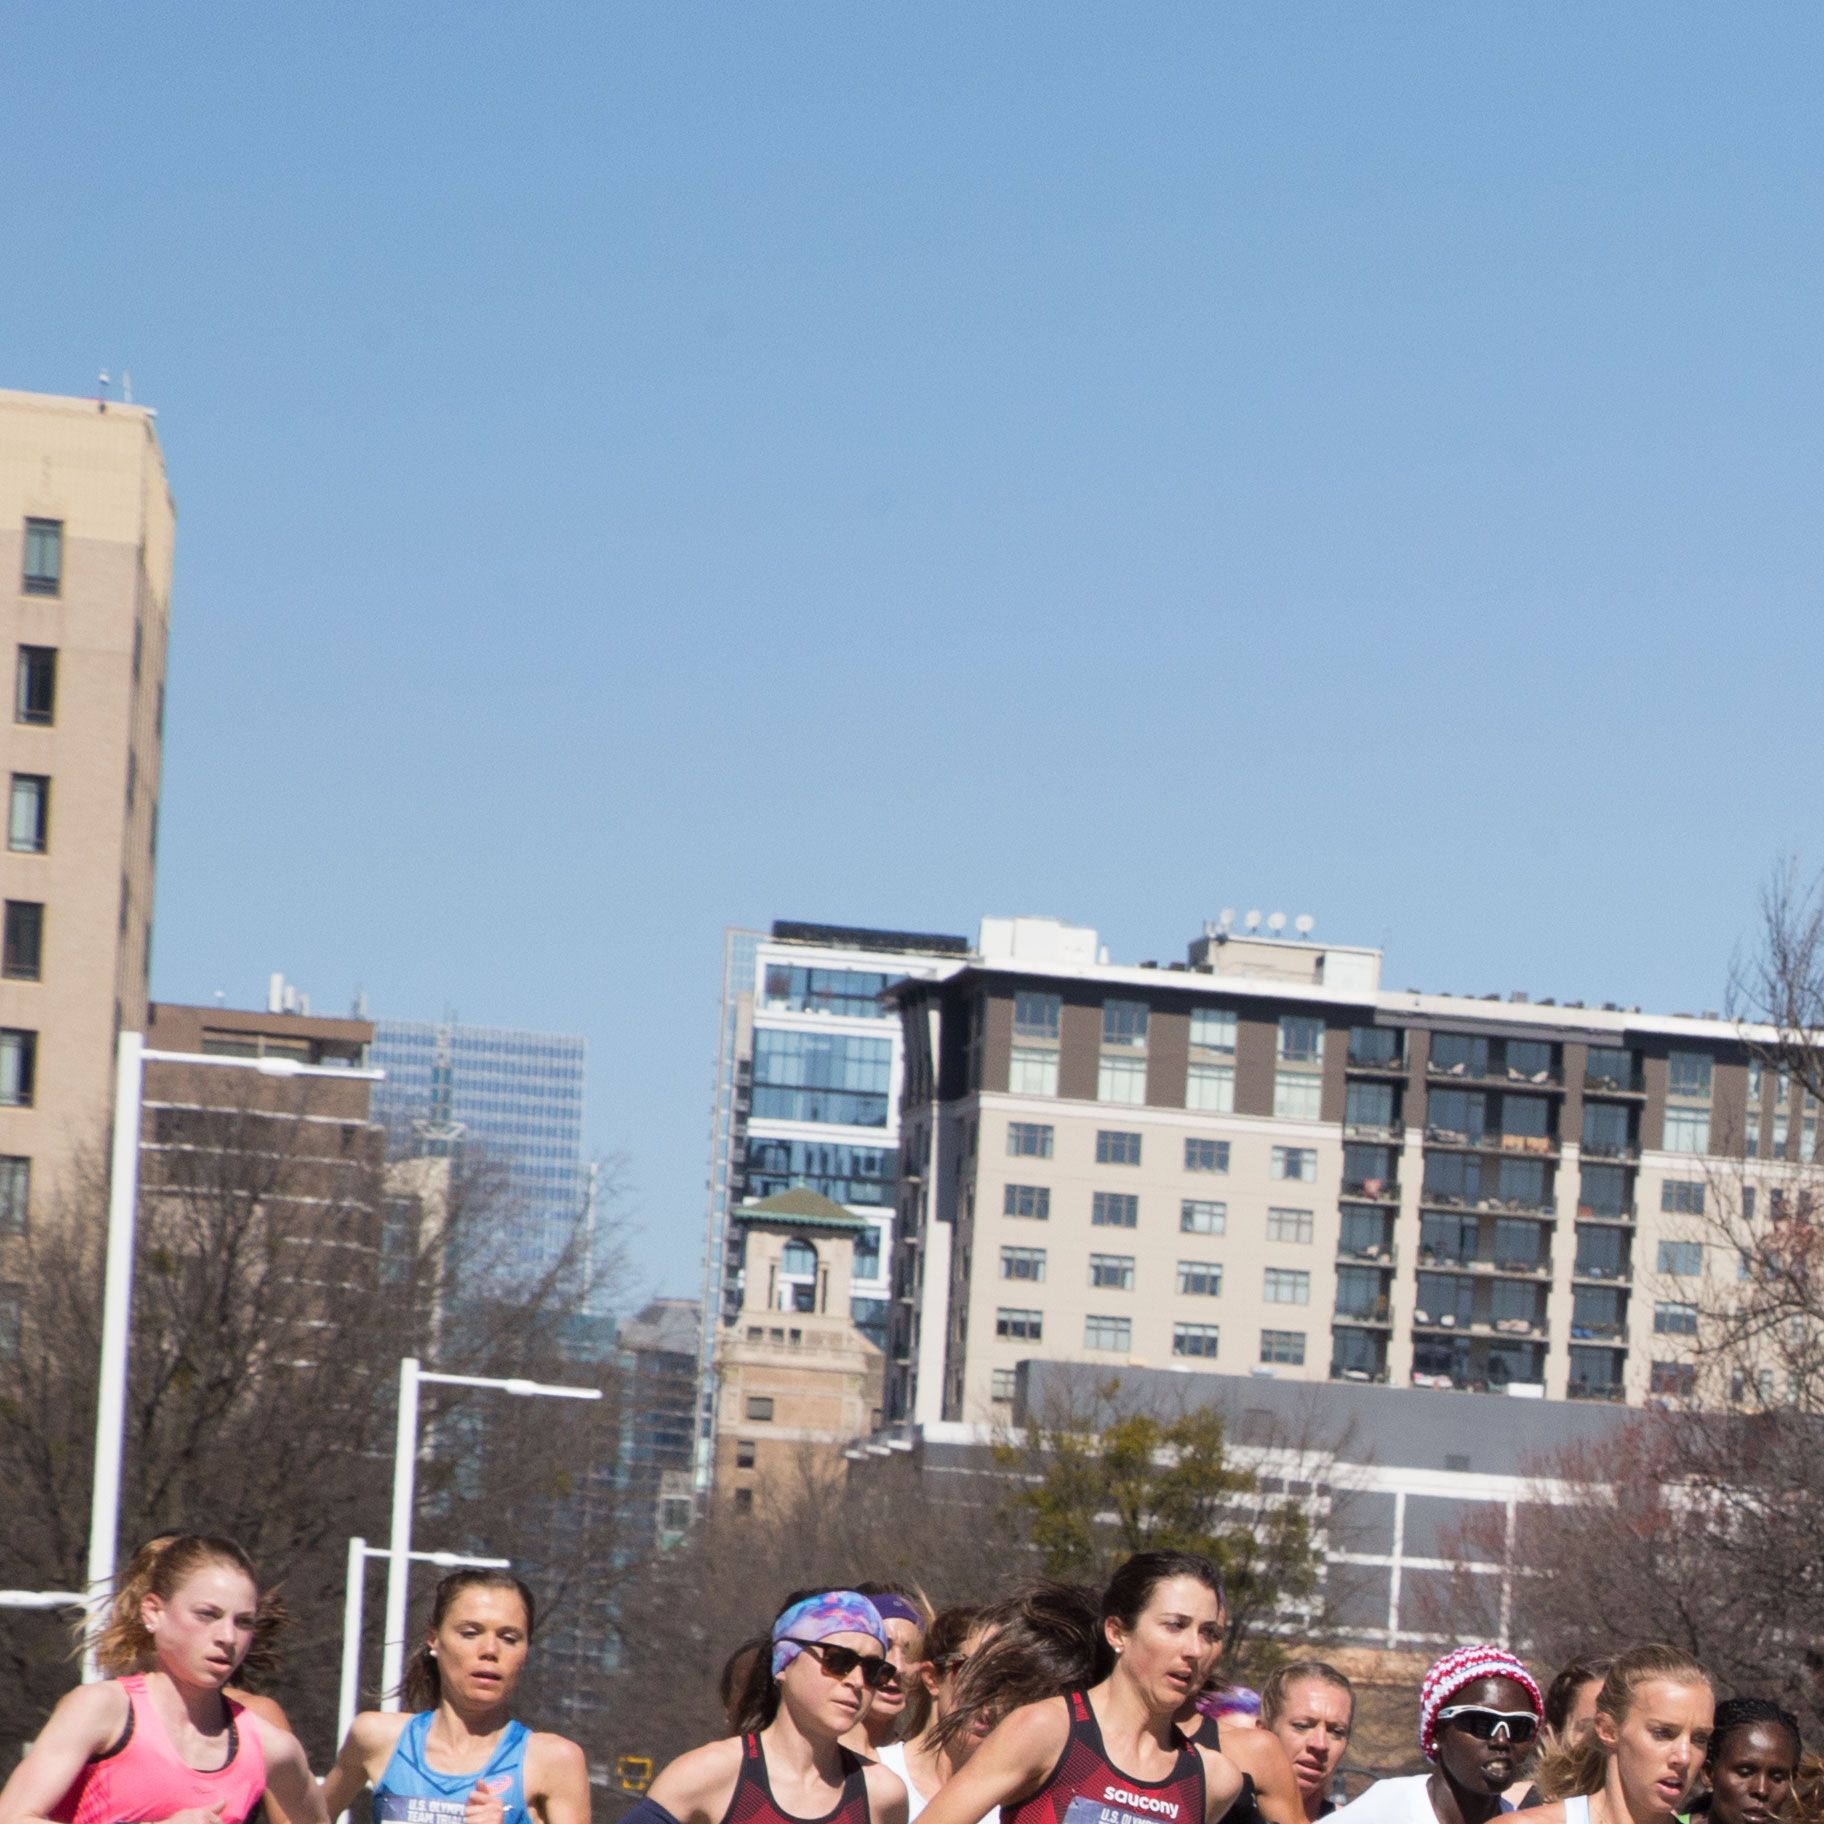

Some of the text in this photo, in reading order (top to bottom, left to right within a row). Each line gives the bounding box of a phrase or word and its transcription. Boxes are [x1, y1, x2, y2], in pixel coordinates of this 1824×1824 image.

[408, 1799, 427, 1811] U.S.
[1103, 1786, 1180, 1819] saucony
[407, 1811, 434, 1824] TEAM
[1101, 1808, 1120, 1824] U.S.
